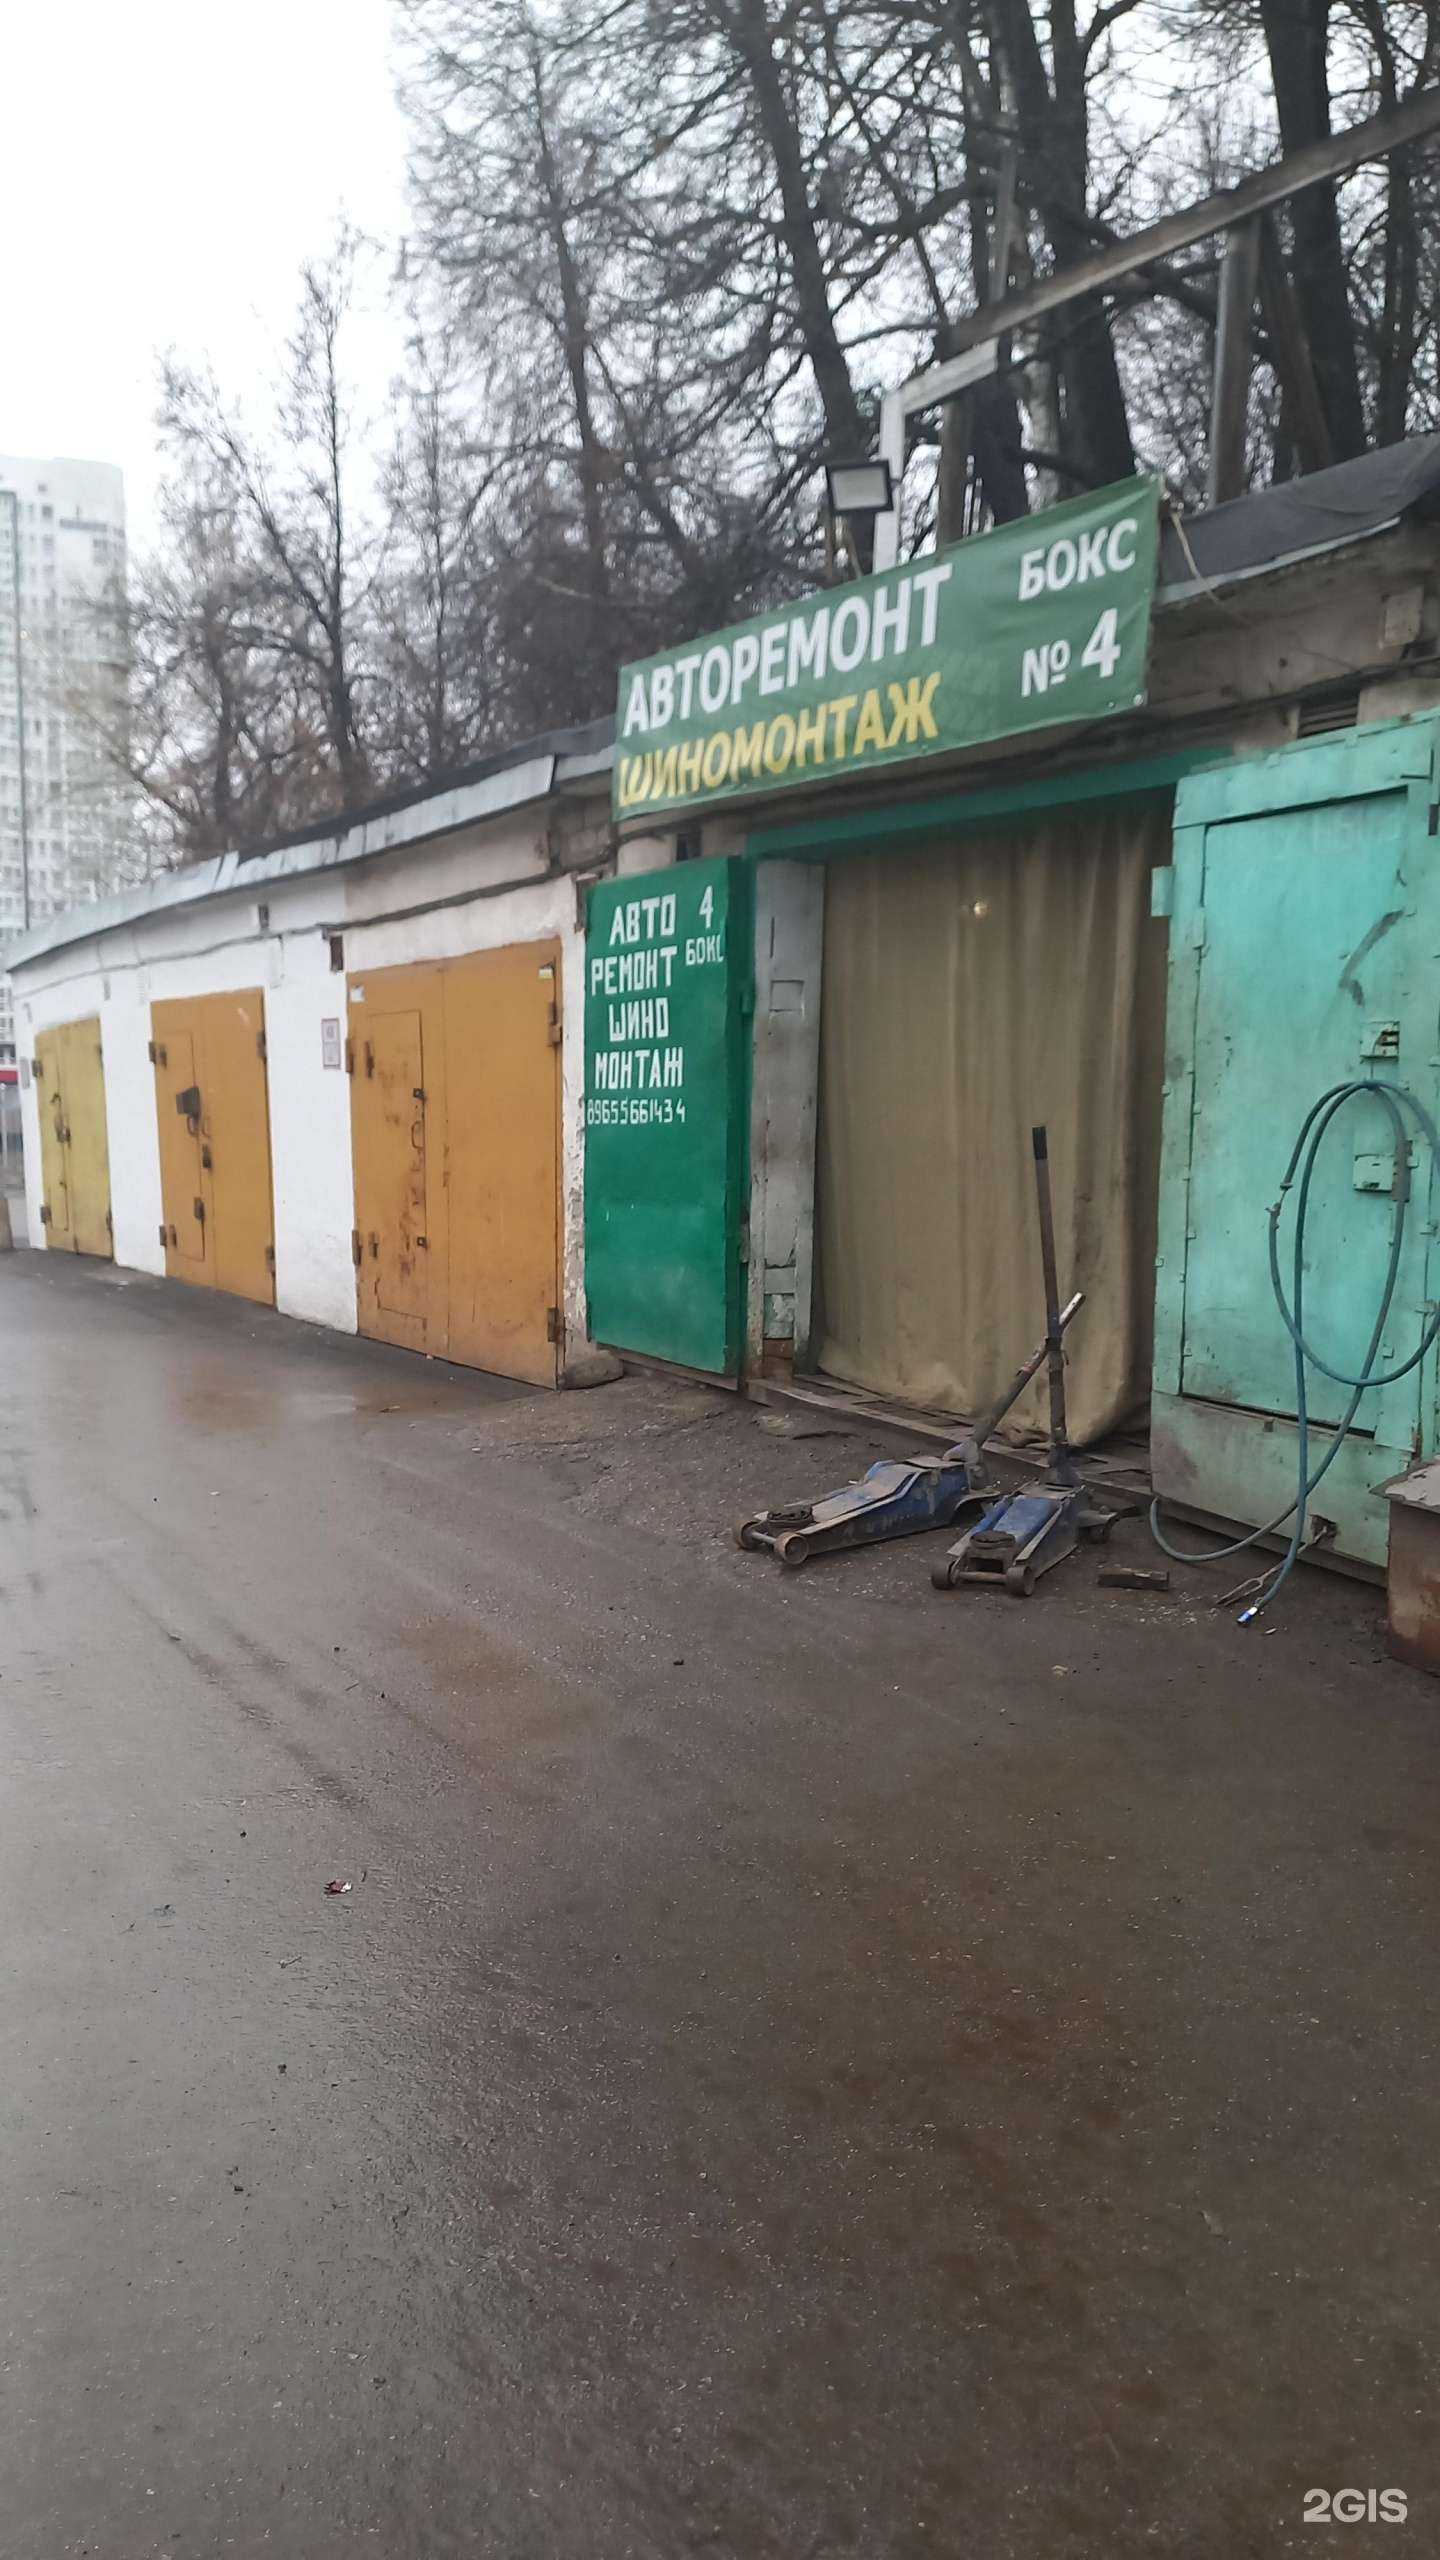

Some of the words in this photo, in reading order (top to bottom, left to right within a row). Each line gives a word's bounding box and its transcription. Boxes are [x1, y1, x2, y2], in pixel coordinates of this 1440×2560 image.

[1018, 518, 1138, 601] БОКС
[622, 564, 953, 738] АВТОРЕМОНТ
[1020, 639, 1071, 697] №
[1081, 608, 1121, 678] 4
[618, 672, 942, 807] ШИНОМОНТАЖ
[609, 894, 676, 946] АВТО
[699, 885, 714, 929] 4
[591, 946, 678, 996] РЕМОНТ
[685, 934, 724, 966] БОКС
[609, 997, 669, 1042] ШИНО
[595, 1046, 684, 1090] МОНТАЖ
[587, 1097, 686, 1125] 89655661434
